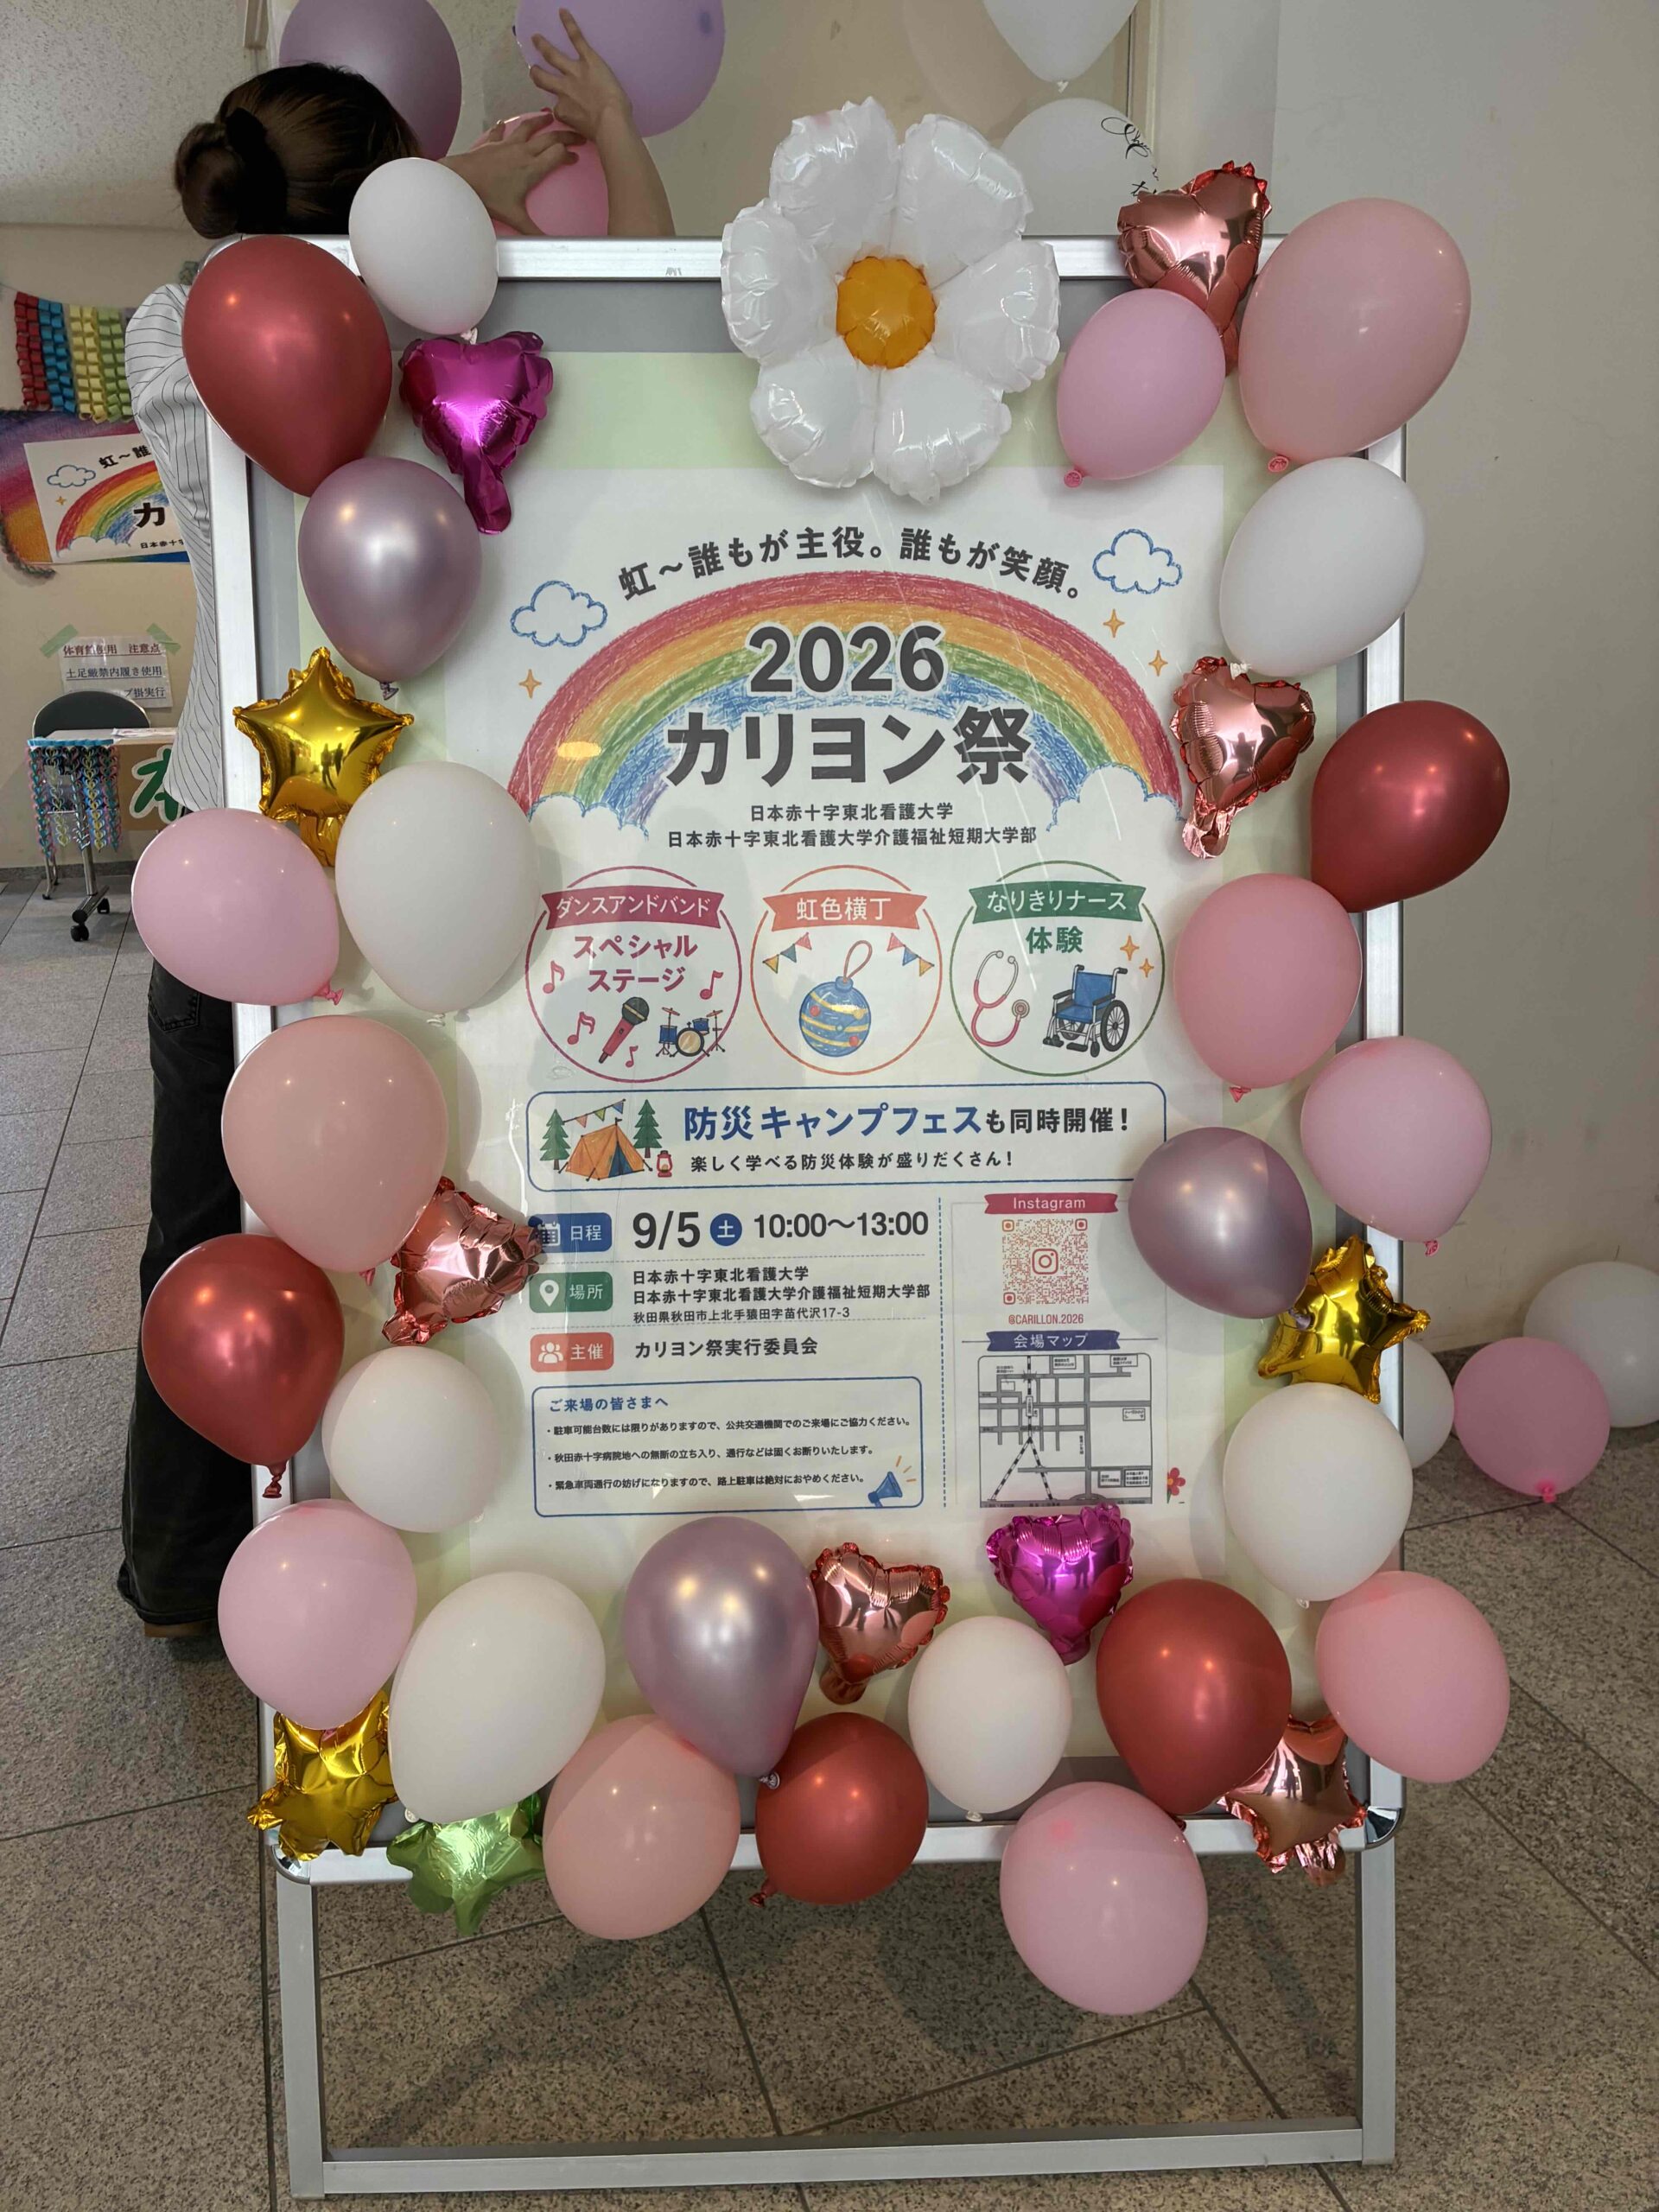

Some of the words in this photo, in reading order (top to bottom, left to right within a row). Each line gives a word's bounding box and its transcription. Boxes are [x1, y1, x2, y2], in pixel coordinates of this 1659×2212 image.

[749, 625, 944, 692] 2026
[666, 705, 1032, 788] カリヨン祭
[750, 802, 954, 822] 日本赤十字東北看護大学
[667, 825, 1038, 848] 日本赤十字東北看護大学介護福祉短期大学部
[556, 893, 711, 918] ダンスアンドバンド
[796, 896, 892, 921] 虹色横丁
[987, 889, 1127, 913] なりきりナース
[573, 934, 698, 959] スペシャル
[1026, 925, 1084, 954] 体験
[588, 966, 686, 993] ステージ
[690, 1150, 1014, 1173] 楽しく学べる防災体験が盛りだくさん！
[1013, 1197, 1086, 1211] Instagram
[570, 1224, 602, 1242] 日程
[632, 1210, 702, 1251] 9/5
[716, 1219, 736, 1239] 土
[753, 1211, 930, 1239] 10:00～13:00
[632, 1266, 810, 1286] 日本赤十字東北看護大学
[569, 1283, 604, 1300] 場所
[632, 1284, 931, 1306] 日本赤十字東北看護大学介護福祉短期大学部
[632, 1306, 850, 1325] 秋田県秋田市上北手猿田字苗代沢17-3
[1007, 1313, 1084, 1325] @CARILLON.2026
[570, 1343, 604, 1360] 主催
[635, 1336, 819, 1359] カリヨン祭実行委員会
[1013, 1333, 1089, 1349] 会場マップ
[549, 1395, 669, 1413] ご来場の皆さまへ
